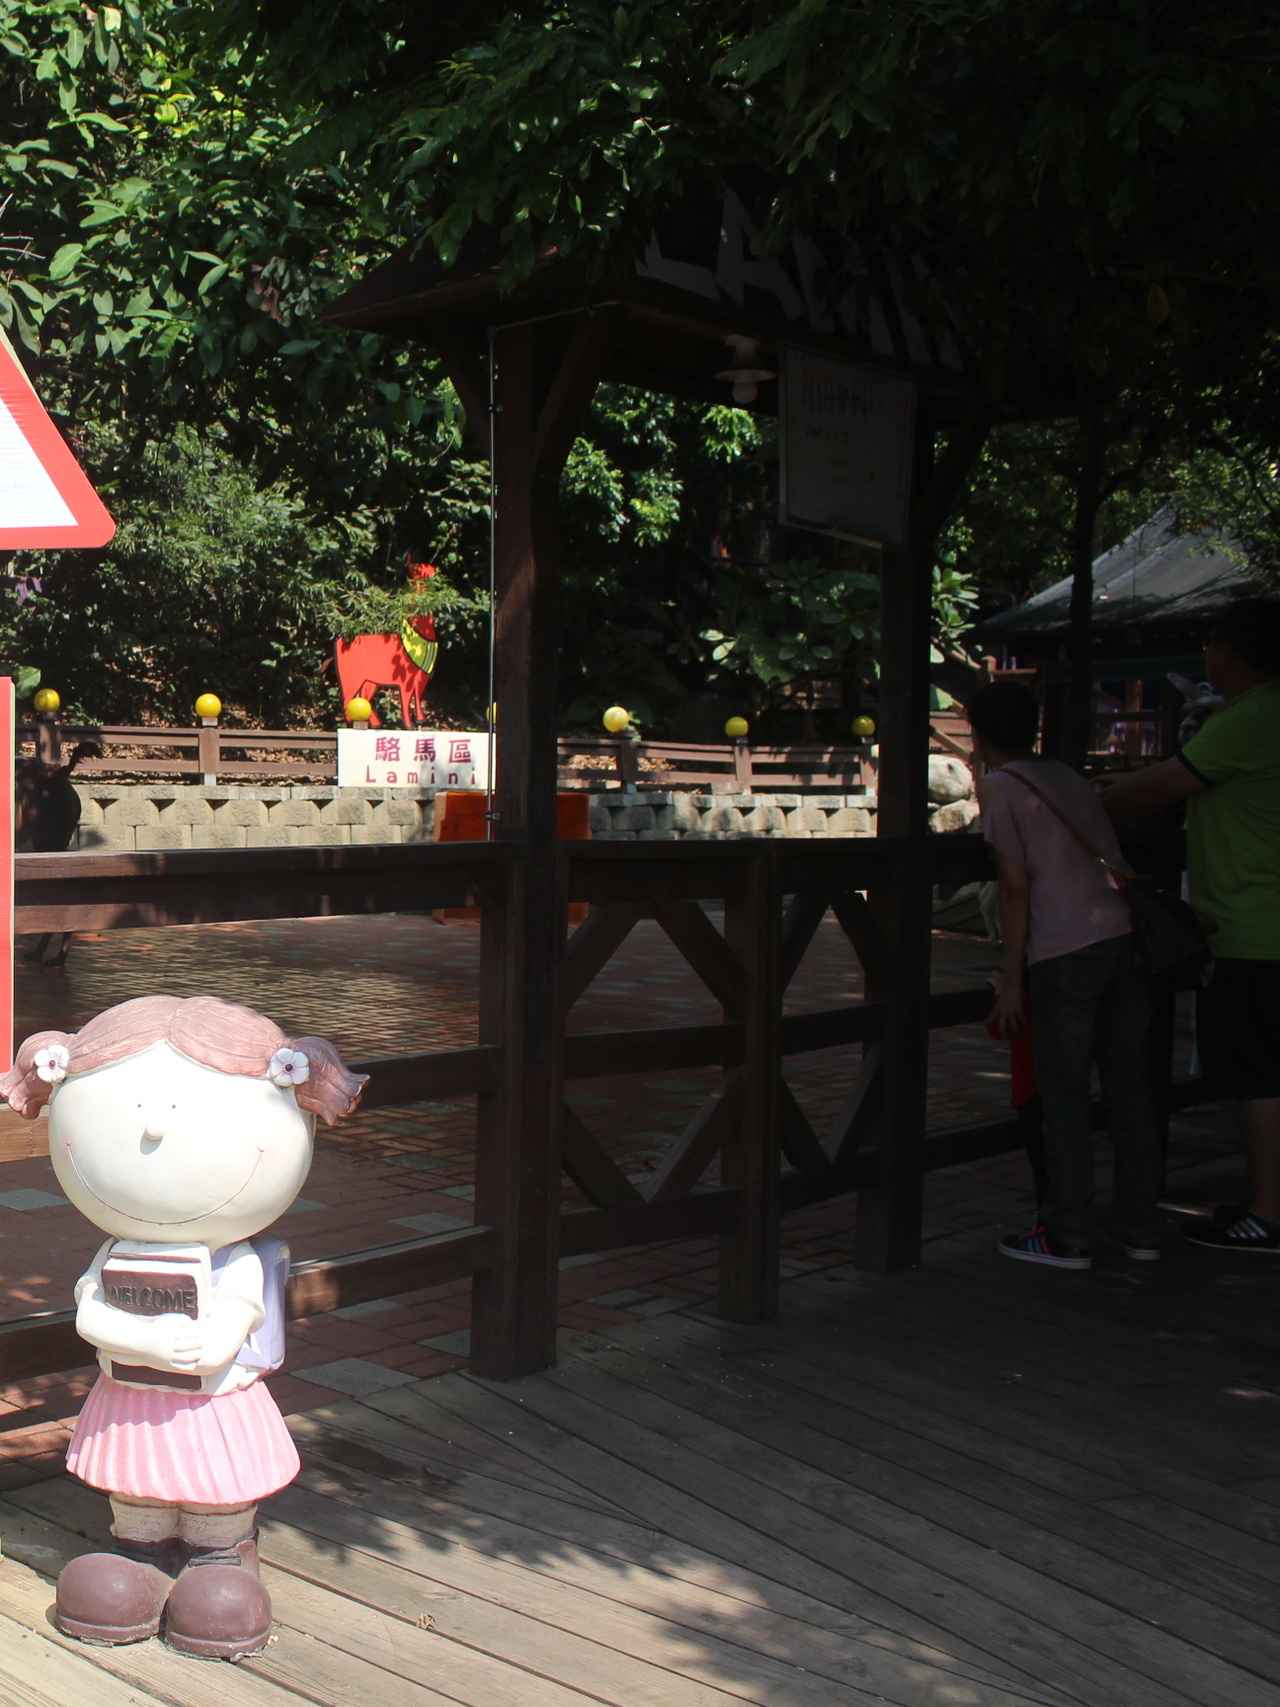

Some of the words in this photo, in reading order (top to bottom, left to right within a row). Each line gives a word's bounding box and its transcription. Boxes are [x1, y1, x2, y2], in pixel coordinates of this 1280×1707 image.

[375, 736, 472, 764] 駱馬區
[365, 764, 477, 785] Lamini
[105, 1285, 197, 1311] WELCOME
